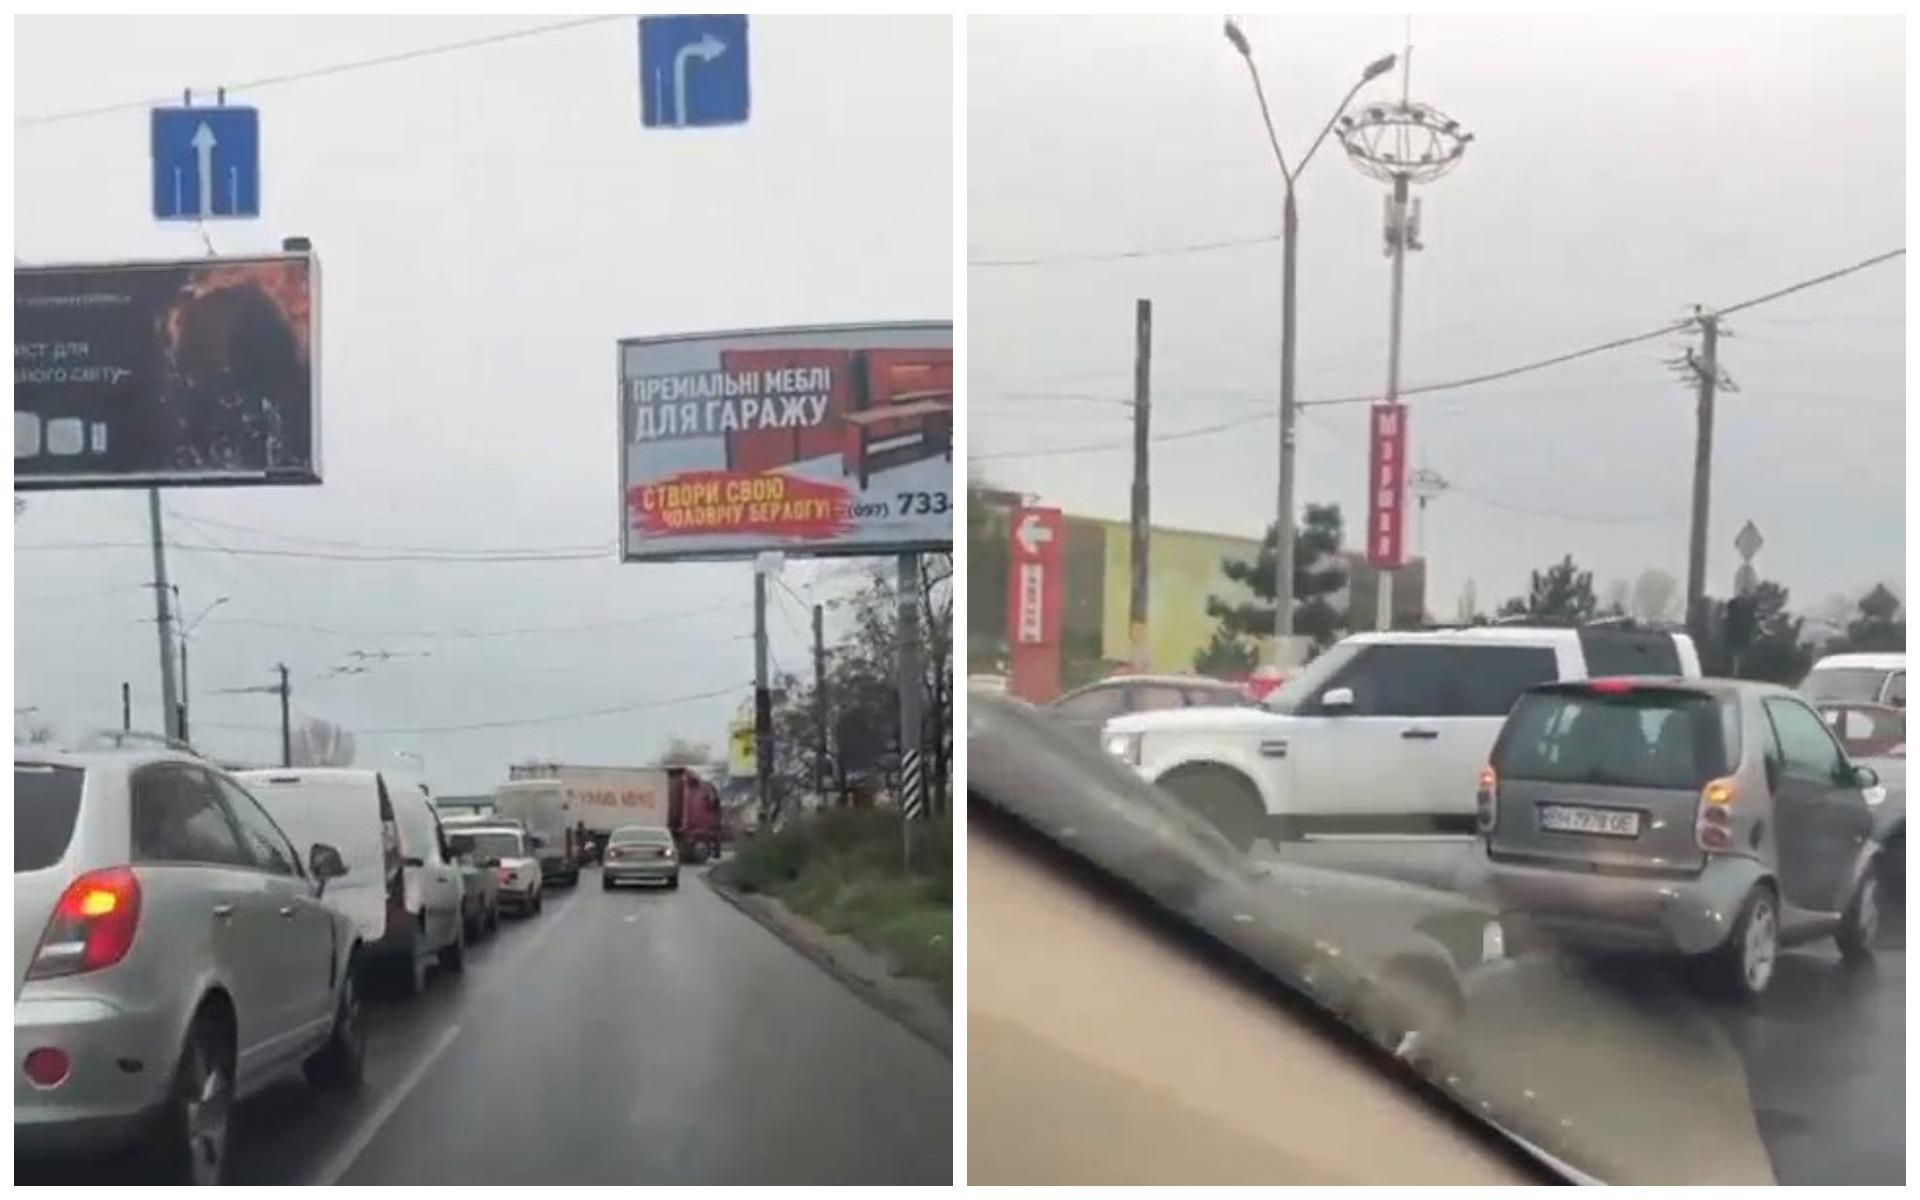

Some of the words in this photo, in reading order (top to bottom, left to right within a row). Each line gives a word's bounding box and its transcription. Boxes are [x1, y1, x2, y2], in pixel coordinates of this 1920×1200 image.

[633, 371, 760, 403] ПРЕМІАЛЬНІ
[764, 365, 832, 392] МЕБЛІ
[635, 402, 698, 441] ДЛЯ
[705, 394, 828, 431] ГАРАЖУ
[642, 480, 721, 511] СТВОРИ
[726, 476, 785, 503] СВОЮ
